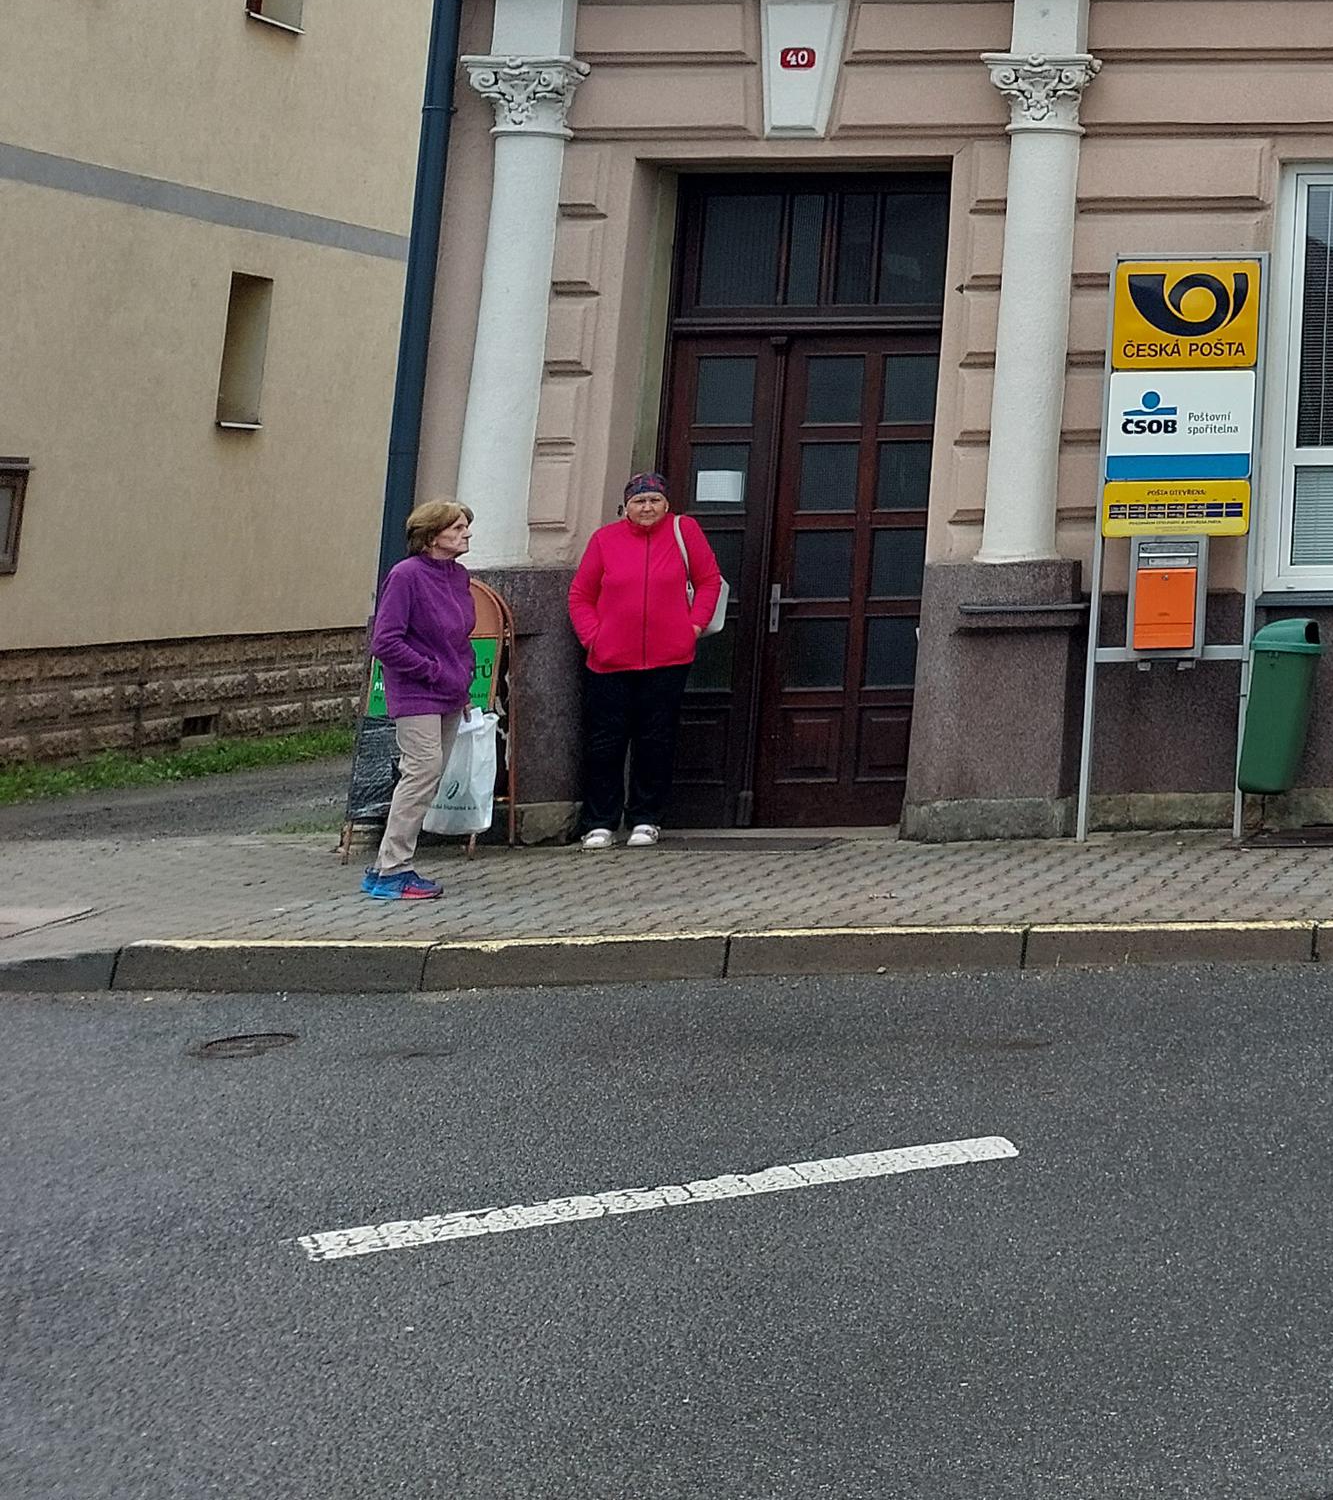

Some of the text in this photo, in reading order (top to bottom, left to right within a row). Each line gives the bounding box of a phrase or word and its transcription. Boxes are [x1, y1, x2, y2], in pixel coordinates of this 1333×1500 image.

[786, 50, 808, 65] 40
[1123, 338, 1246, 358] ČESKÁ POŠTA
[1188, 411, 1231, 422] Poštovní
[1121, 418, 1178, 434] ČSOB
[1187, 424, 1239, 436] spořitelna
